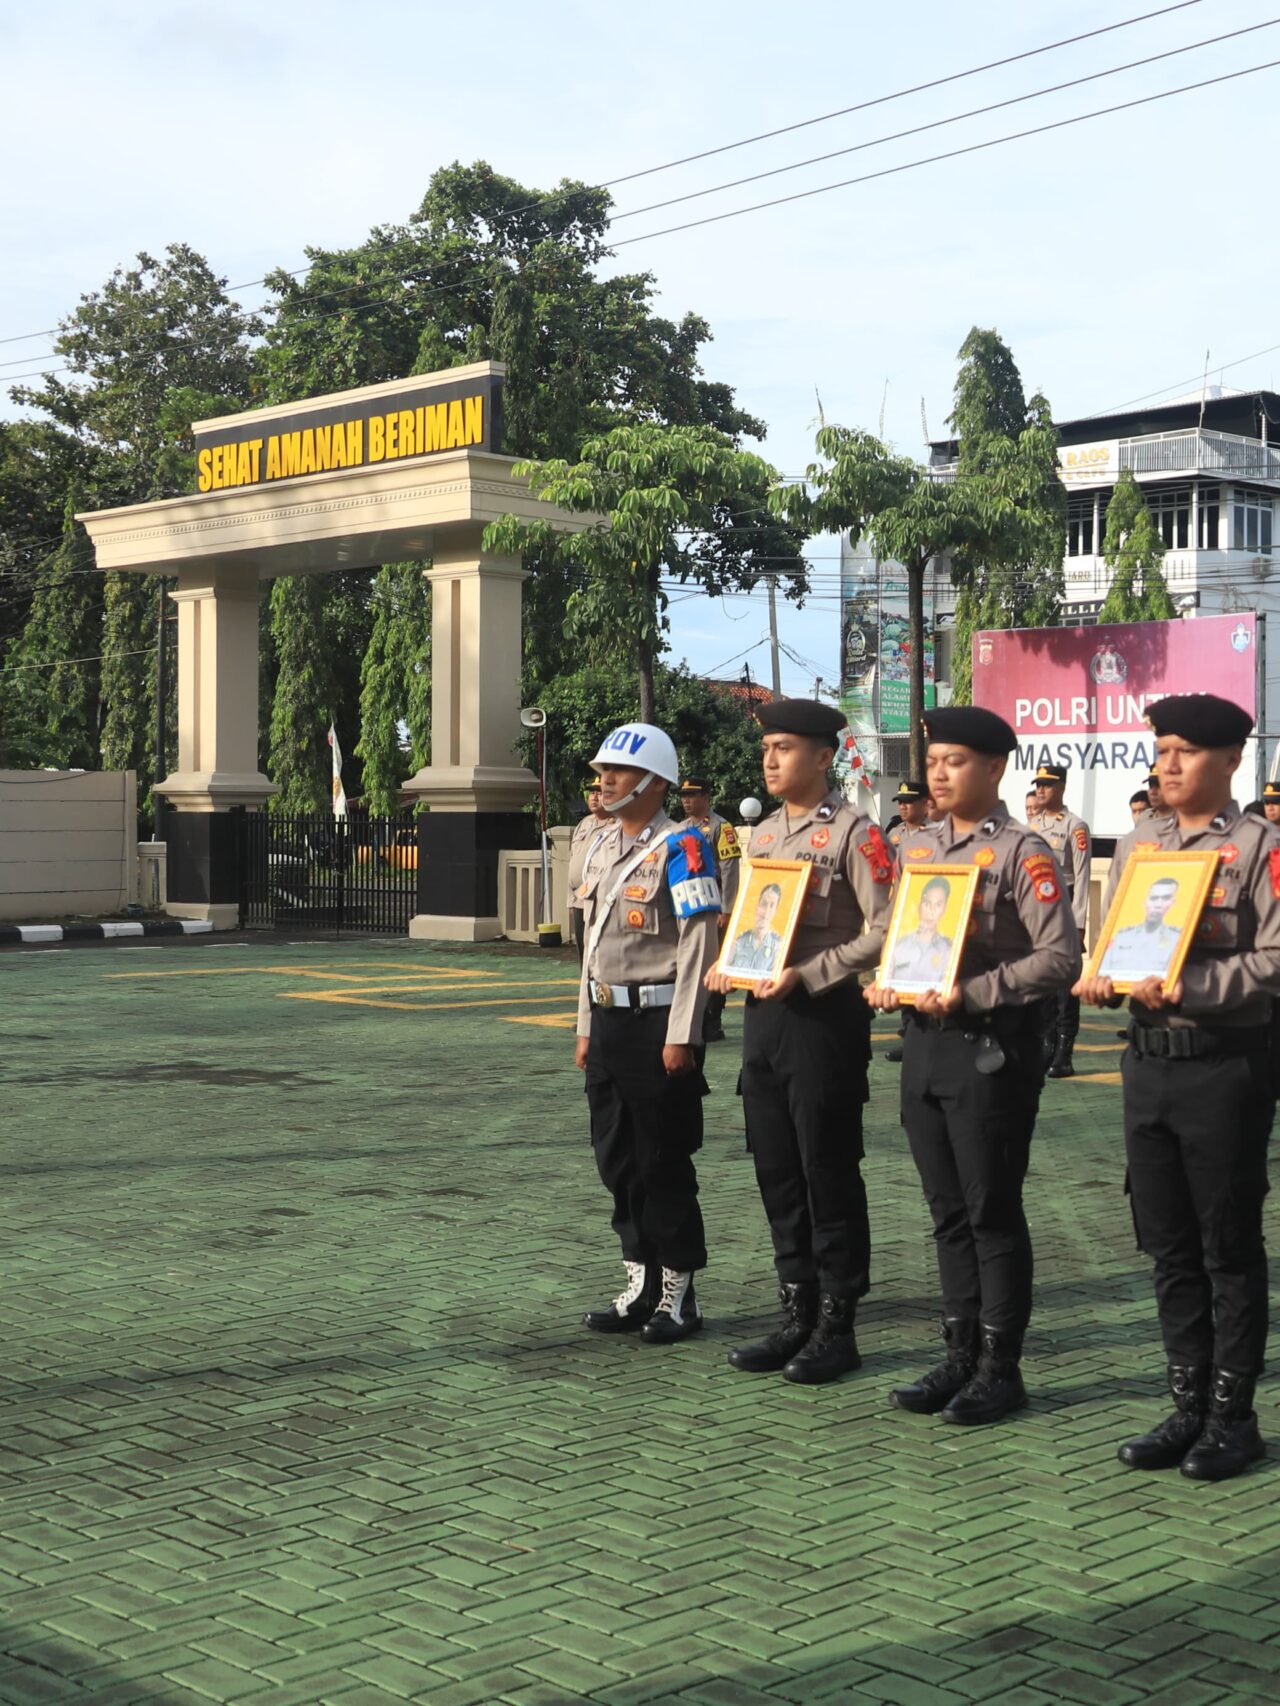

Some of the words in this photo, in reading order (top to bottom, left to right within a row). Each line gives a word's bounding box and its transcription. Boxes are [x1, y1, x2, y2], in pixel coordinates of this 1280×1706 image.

[198, 439, 263, 493] SEHAT
[266, 419, 363, 480] AMANAH
[369, 395, 483, 463] BERIMAN
[1015, 696, 1097, 728] POLRI
[1014, 741, 1159, 771] MASYARA
[633, 868, 659, 878] OLRI
[795, 852, 835, 867] POLRI
